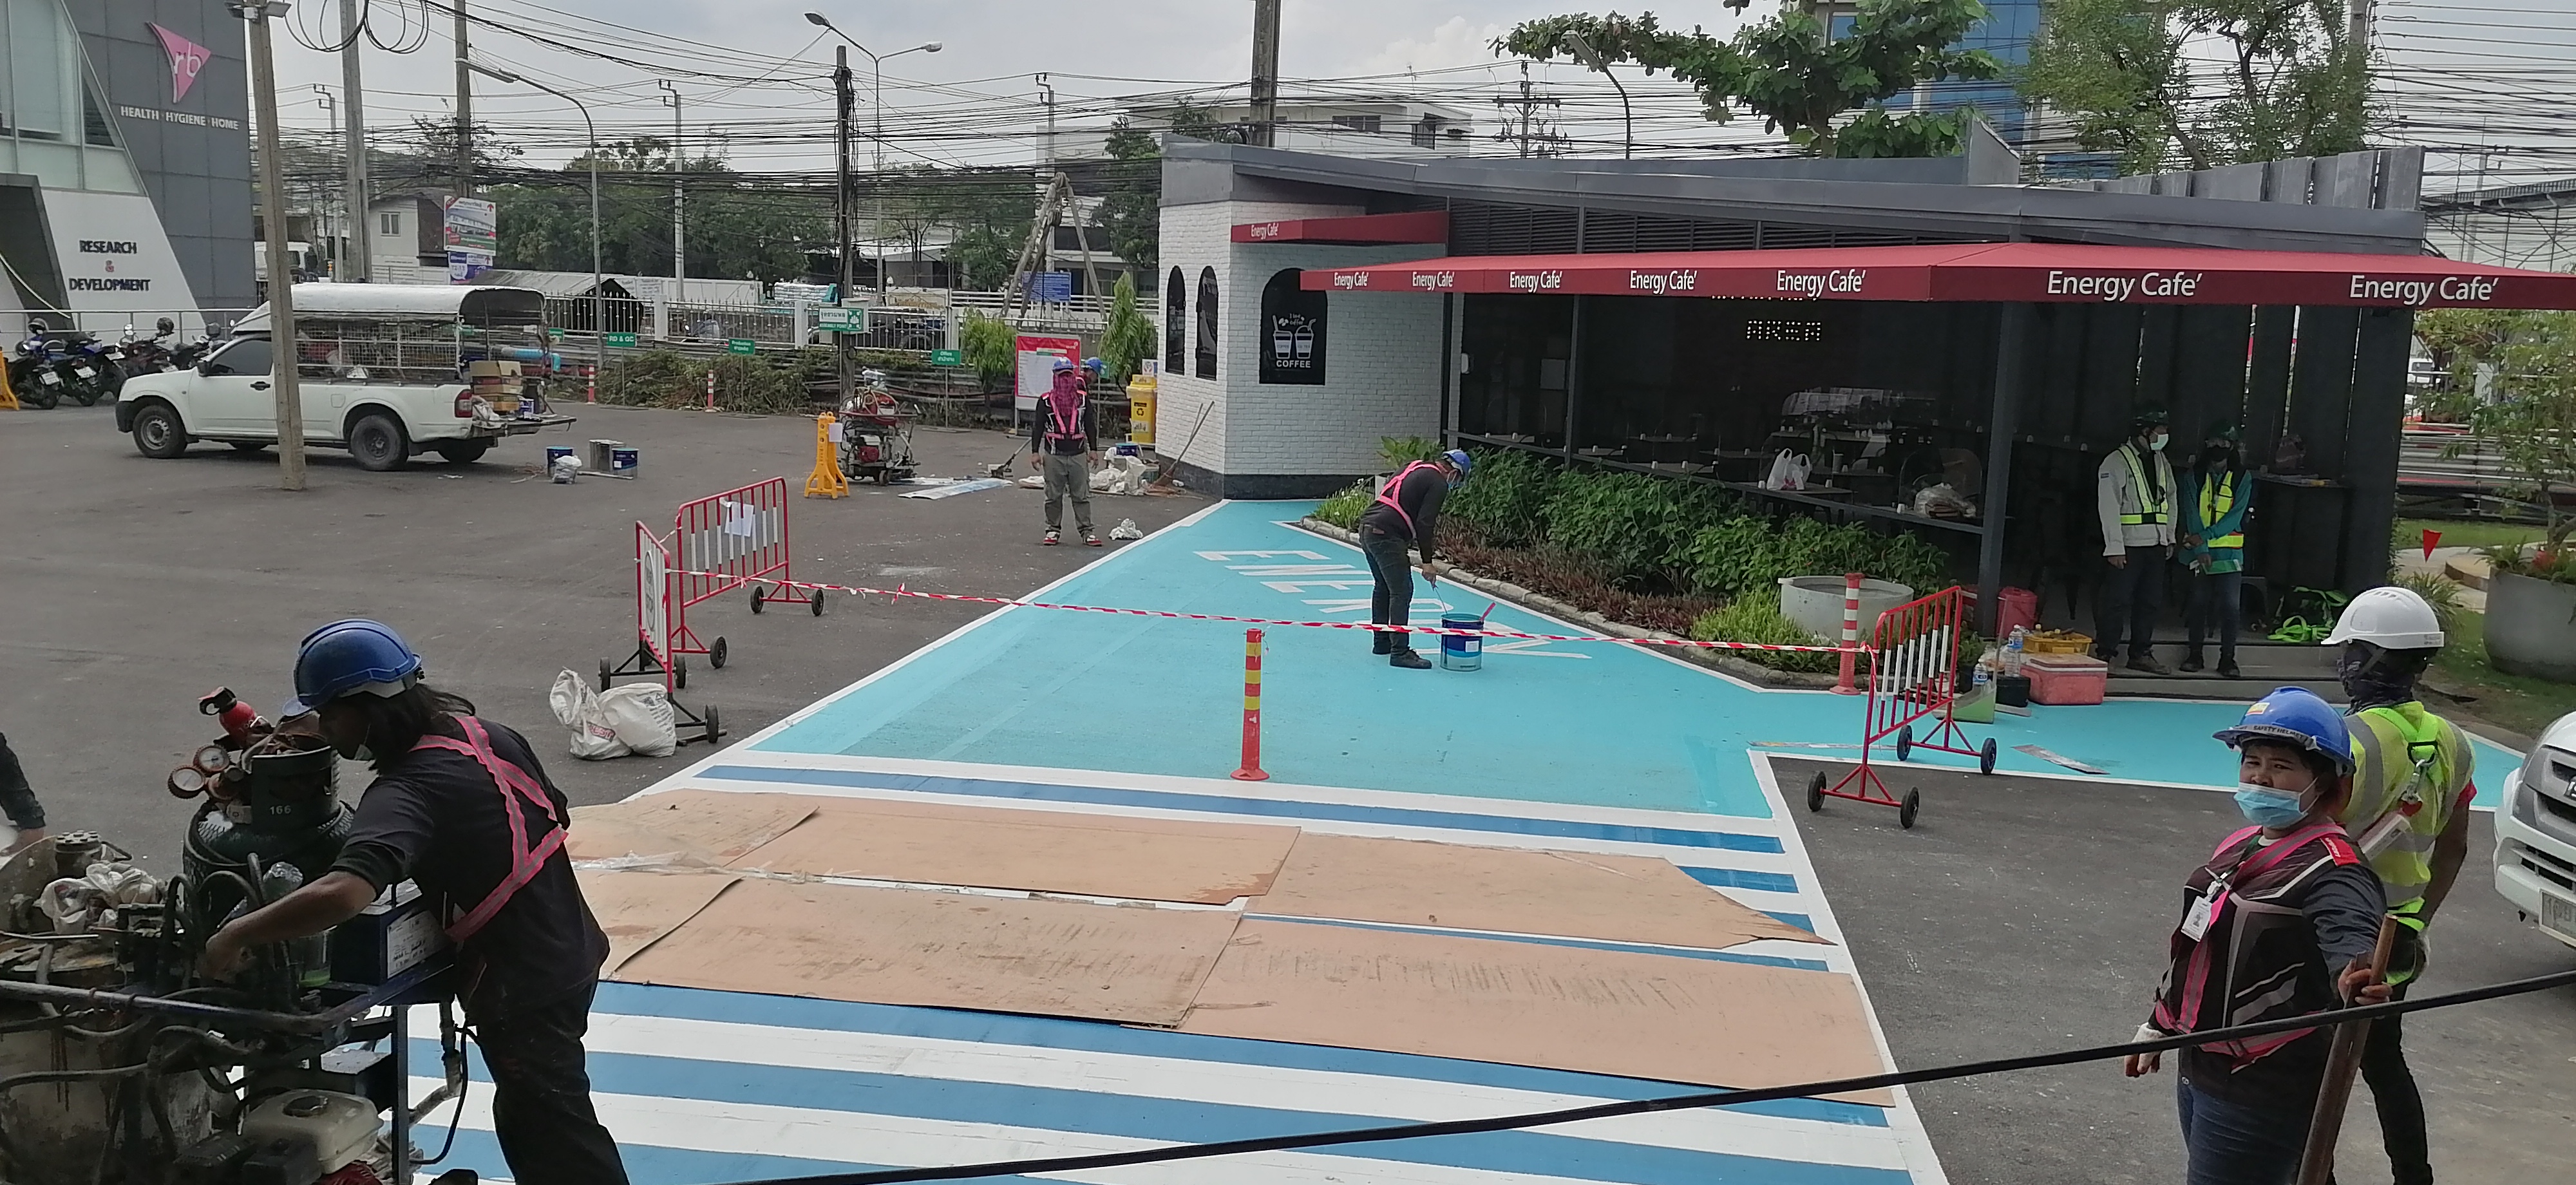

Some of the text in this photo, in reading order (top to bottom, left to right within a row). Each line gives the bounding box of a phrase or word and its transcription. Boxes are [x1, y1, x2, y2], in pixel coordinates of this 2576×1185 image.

[173, 41, 202, 78] rb
[120, 106, 239, 130] HEALTH HYGIENE HOME
[1251, 224, 1267, 240] Energy
[79, 240, 137, 254] RESEARCH
[105, 260, 115, 272] &
[68, 278, 151, 291] DEVELOPMENT
[1334, 272, 1353, 289] Energy
[1412, 271, 1436, 290] Energy
[1510, 271, 1539, 293] Energy
[1630, 270, 1667, 294] Energy
[1777, 270, 1826, 298] Energy
[2047, 270, 2136, 301] Energy
[2350, 275, 2434, 305] Energy
[1276, 359, 1311, 368] COFFEE
[269, 805, 291, 815] 166
